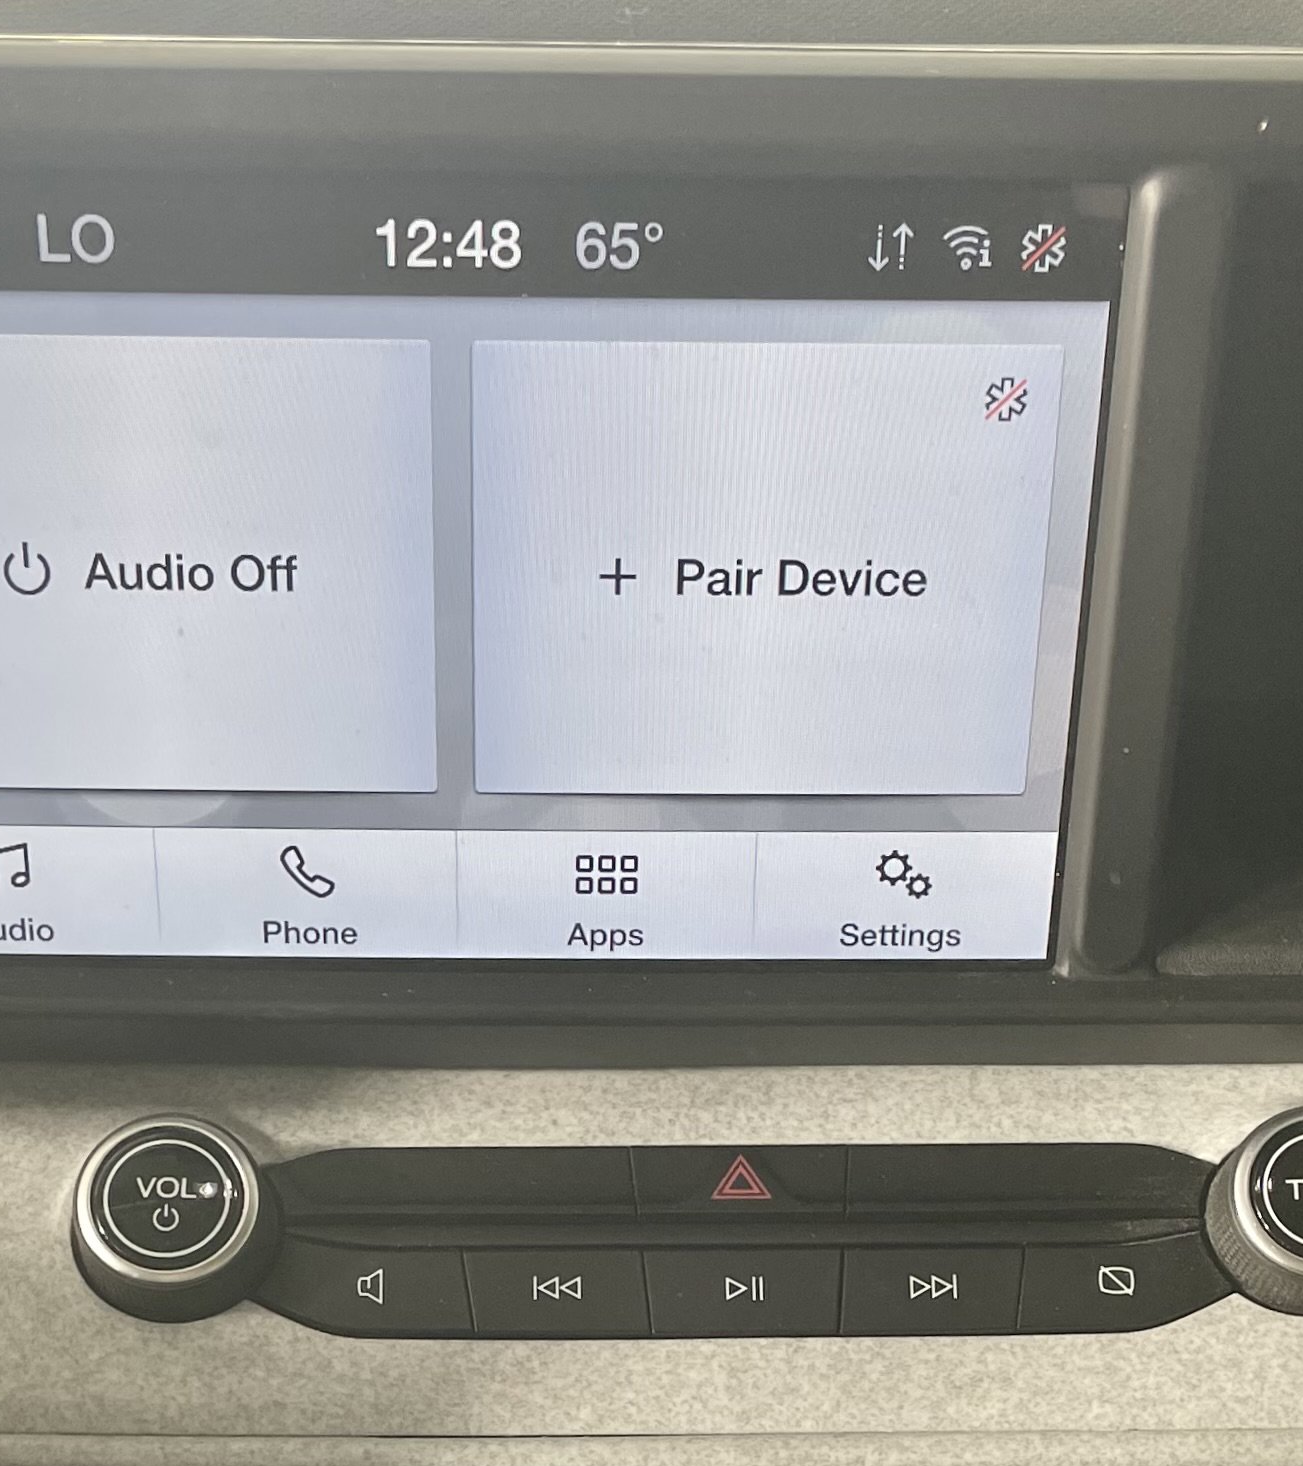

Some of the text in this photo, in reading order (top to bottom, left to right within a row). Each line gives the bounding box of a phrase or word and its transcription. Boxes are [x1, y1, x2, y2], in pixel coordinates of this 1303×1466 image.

[36, 213, 116, 264] LO
[376, 218, 523, 269] 12:48
[84, 553, 298, 592] Audio Off
[675, 558, 928, 597] Pair Device
[262, 921, 358, 946] Phone
[567, 923, 644, 949] Apps
[839, 923, 961, 949] Settings
[136, 1176, 196, 1199] VOL
